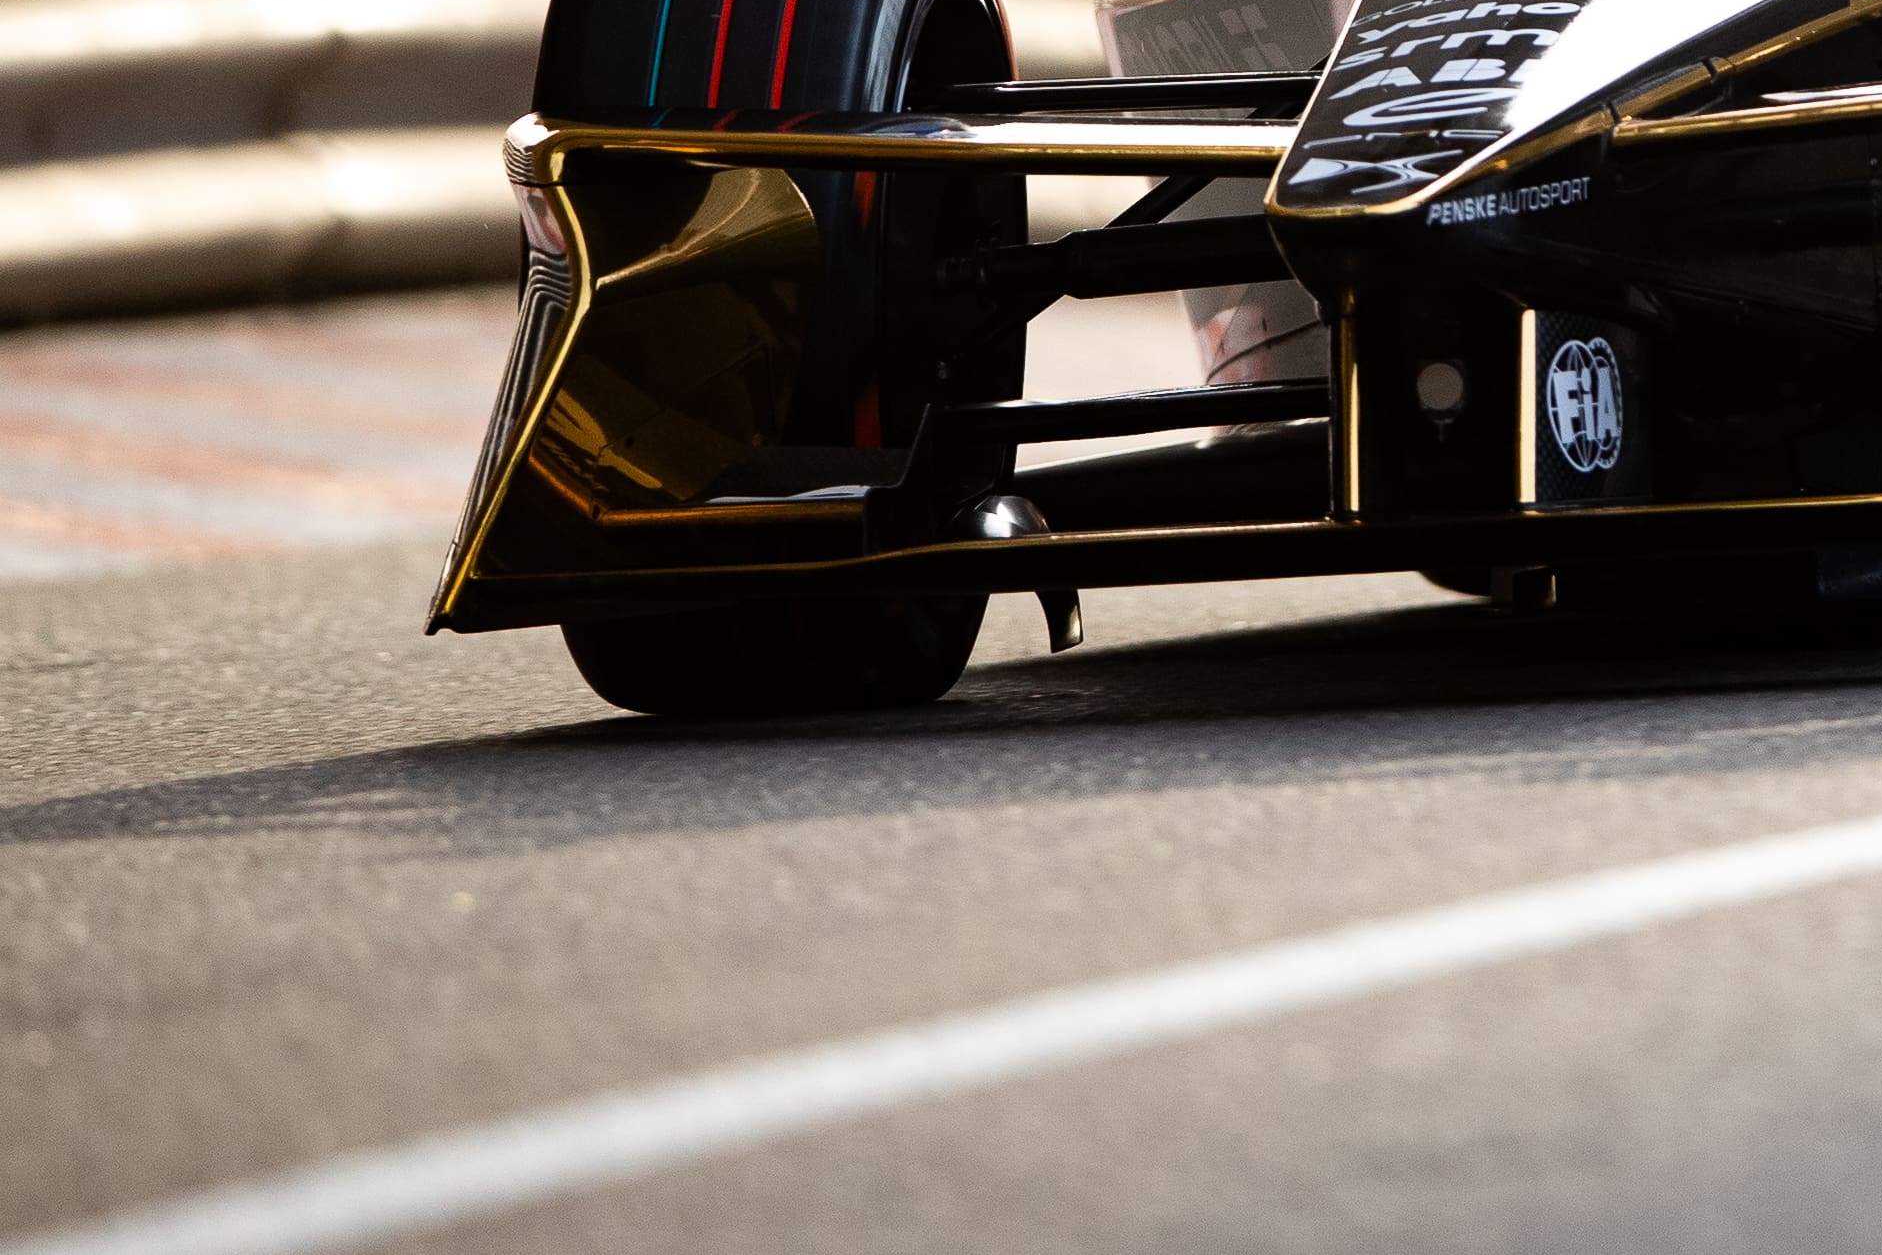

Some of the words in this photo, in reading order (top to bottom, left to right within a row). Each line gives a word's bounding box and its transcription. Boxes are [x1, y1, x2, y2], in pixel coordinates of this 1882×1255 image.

[1357, 1, 1584, 45] yaho
[1426, 193, 1497, 226] PENSKE
[1498, 176, 1592, 216] AUTOSPORT
